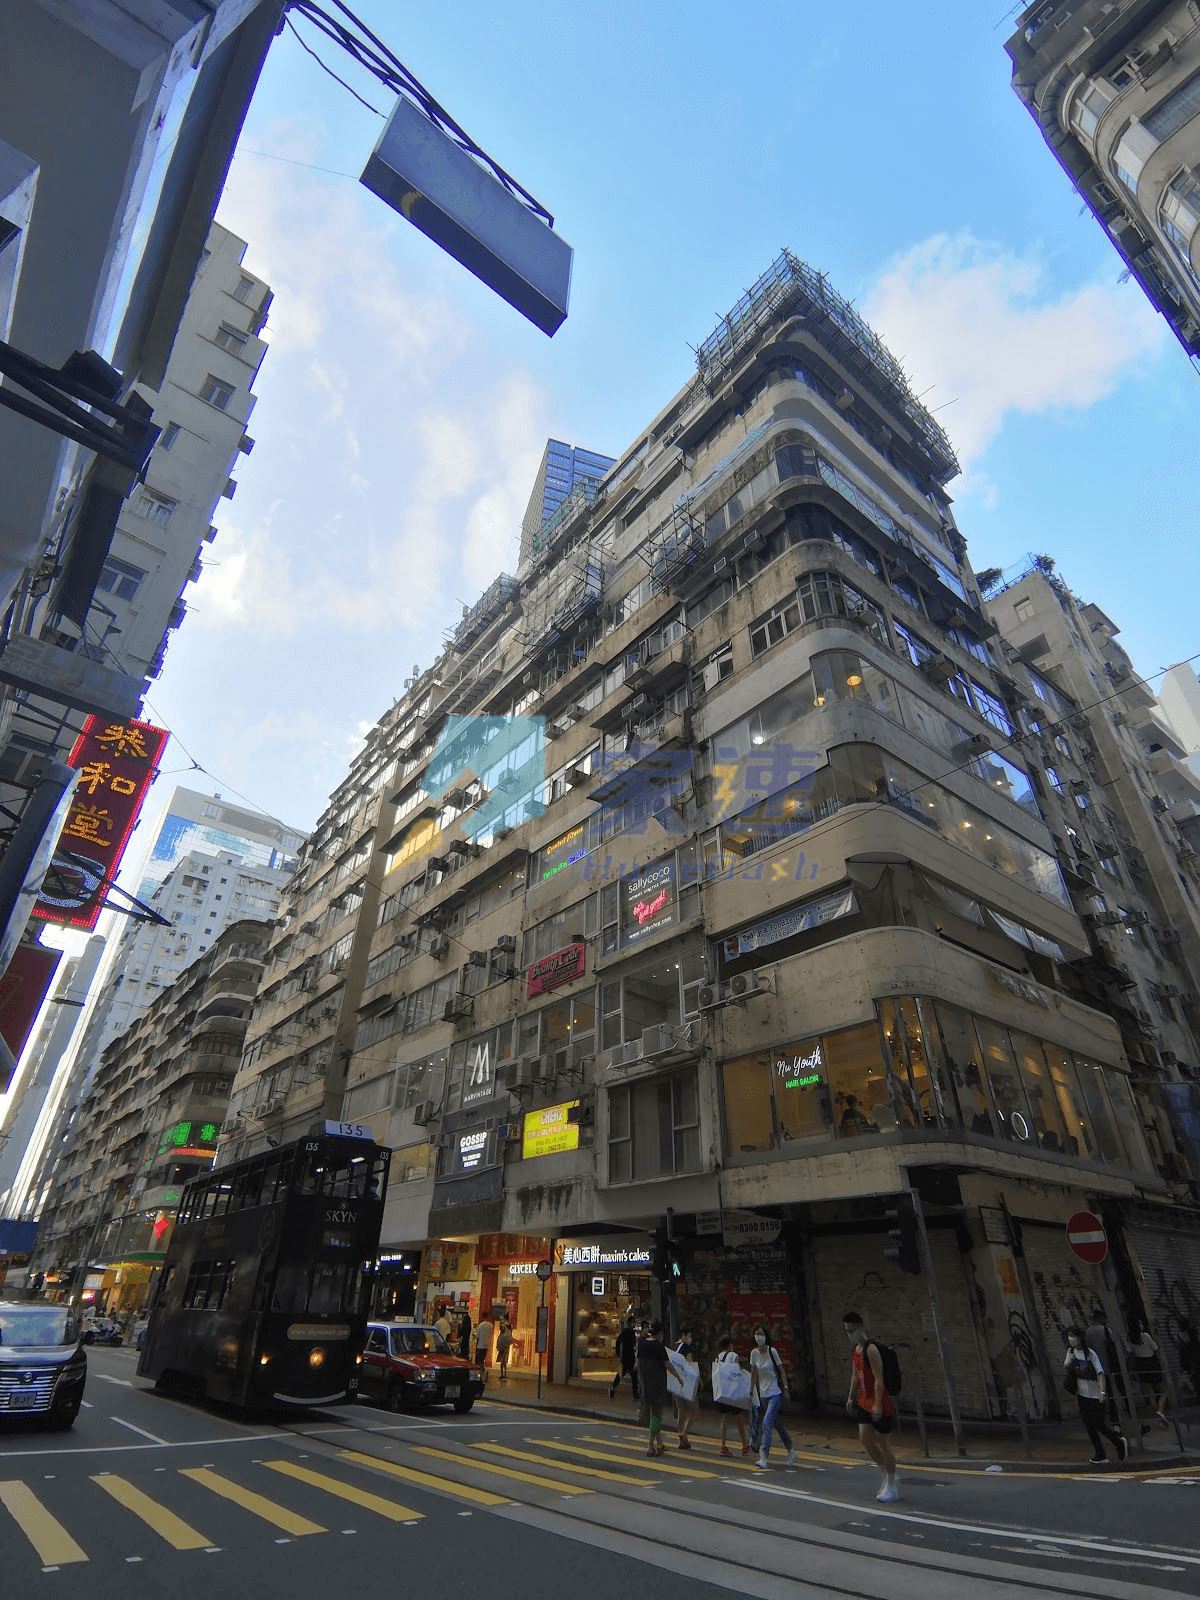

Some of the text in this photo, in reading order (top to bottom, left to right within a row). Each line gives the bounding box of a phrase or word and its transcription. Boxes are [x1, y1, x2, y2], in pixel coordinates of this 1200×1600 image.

[628, 865, 671, 894] sallycoco
[792, 1045, 823, 1078] Youth
[799, 1074, 821, 1087] SALON
[339, 1122, 364, 1137] 135
[459, 1130, 488, 1148] GOSSIP
[305, 1141, 320, 1152] 135
[379, 1151, 390, 1161] 135
[324, 1209, 358, 1224] SKYN
[739, 1222, 759, 1234] 8300
[760, 1220, 780, 1232] 0158
[563, 1245, 600, 1266] 美心西餅
[600, 1249, 628, 1264] maxim's
[628, 1247, 651, 1263] cakes
[509, 1263, 534, 1275] GLYCEL
[348, 1378, 360, 1390] 135
